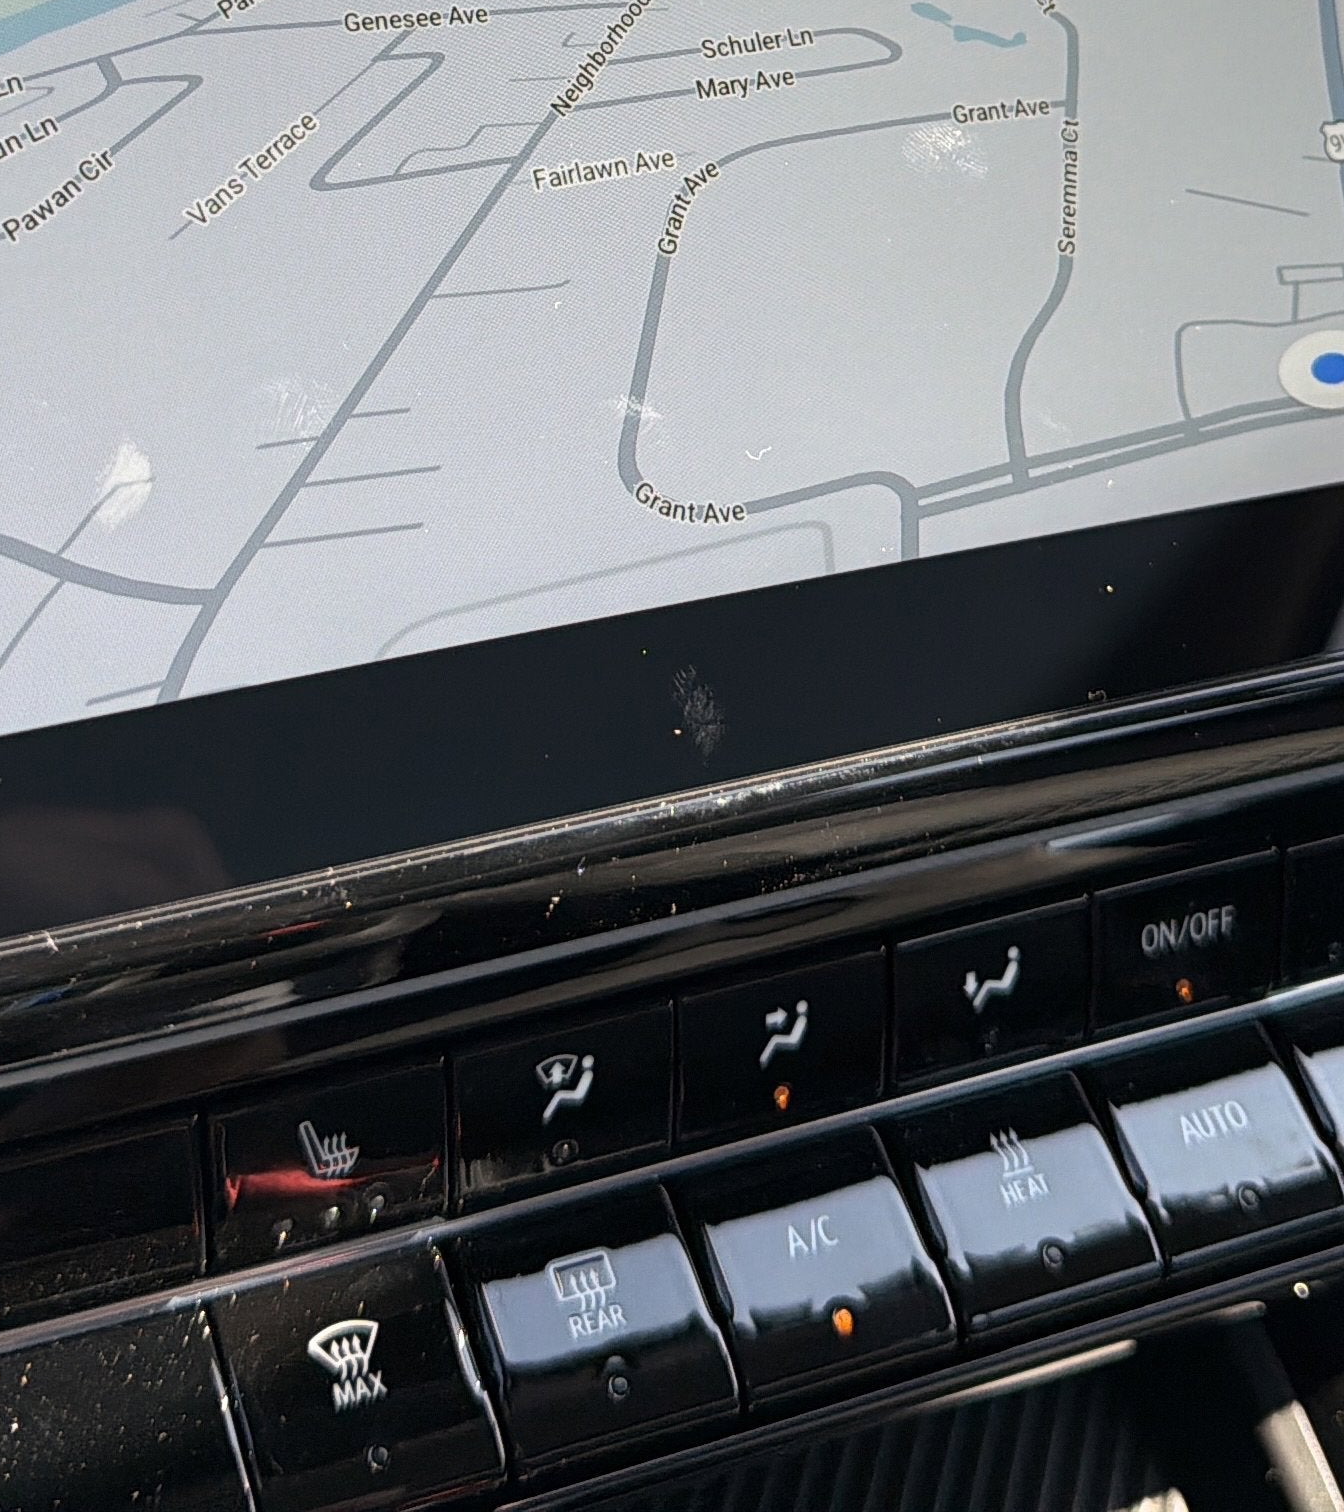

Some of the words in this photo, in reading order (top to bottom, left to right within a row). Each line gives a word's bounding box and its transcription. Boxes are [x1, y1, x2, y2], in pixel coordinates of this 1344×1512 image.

[344, 7, 443, 33] Genesee
[447, 3, 489, 26] Ave
[701, 30, 783, 60] Schuler
[785, 27, 814, 47] Ln
[695, 75, 752, 100] Mary
[754, 68, 796, 90] Ave
[25, 115, 59, 147] Ln
[952, 101, 1012, 125] Grant
[1014, 96, 1050, 119] Ave
[1060, 119, 1080, 144] Ct
[185, 174, 245, 230] Vans
[239, 110, 318, 183] Terrace
[531, 156, 629, 192] Fairlawn
[633, 149, 676, 174] Ave
[1, 171, 81, 243] Pawan
[78, 148, 116, 185] Cir
[656, 186, 692, 257] Grant
[684, 160, 720, 196] Ave
[1058, 149, 1078, 255] Seremma
[635, 481, 696, 523] Grant
[703, 500, 747, 524] Ave
[1141, 903, 1238, 957] ON/OFF
[1179, 1100, 1249, 1148] AUTO
[999, 1172, 1049, 1209] HEAT
[785, 1213, 840, 1259] A/C
[568, 1302, 628, 1341] REAR
[332, 1368, 388, 1414] MAX
